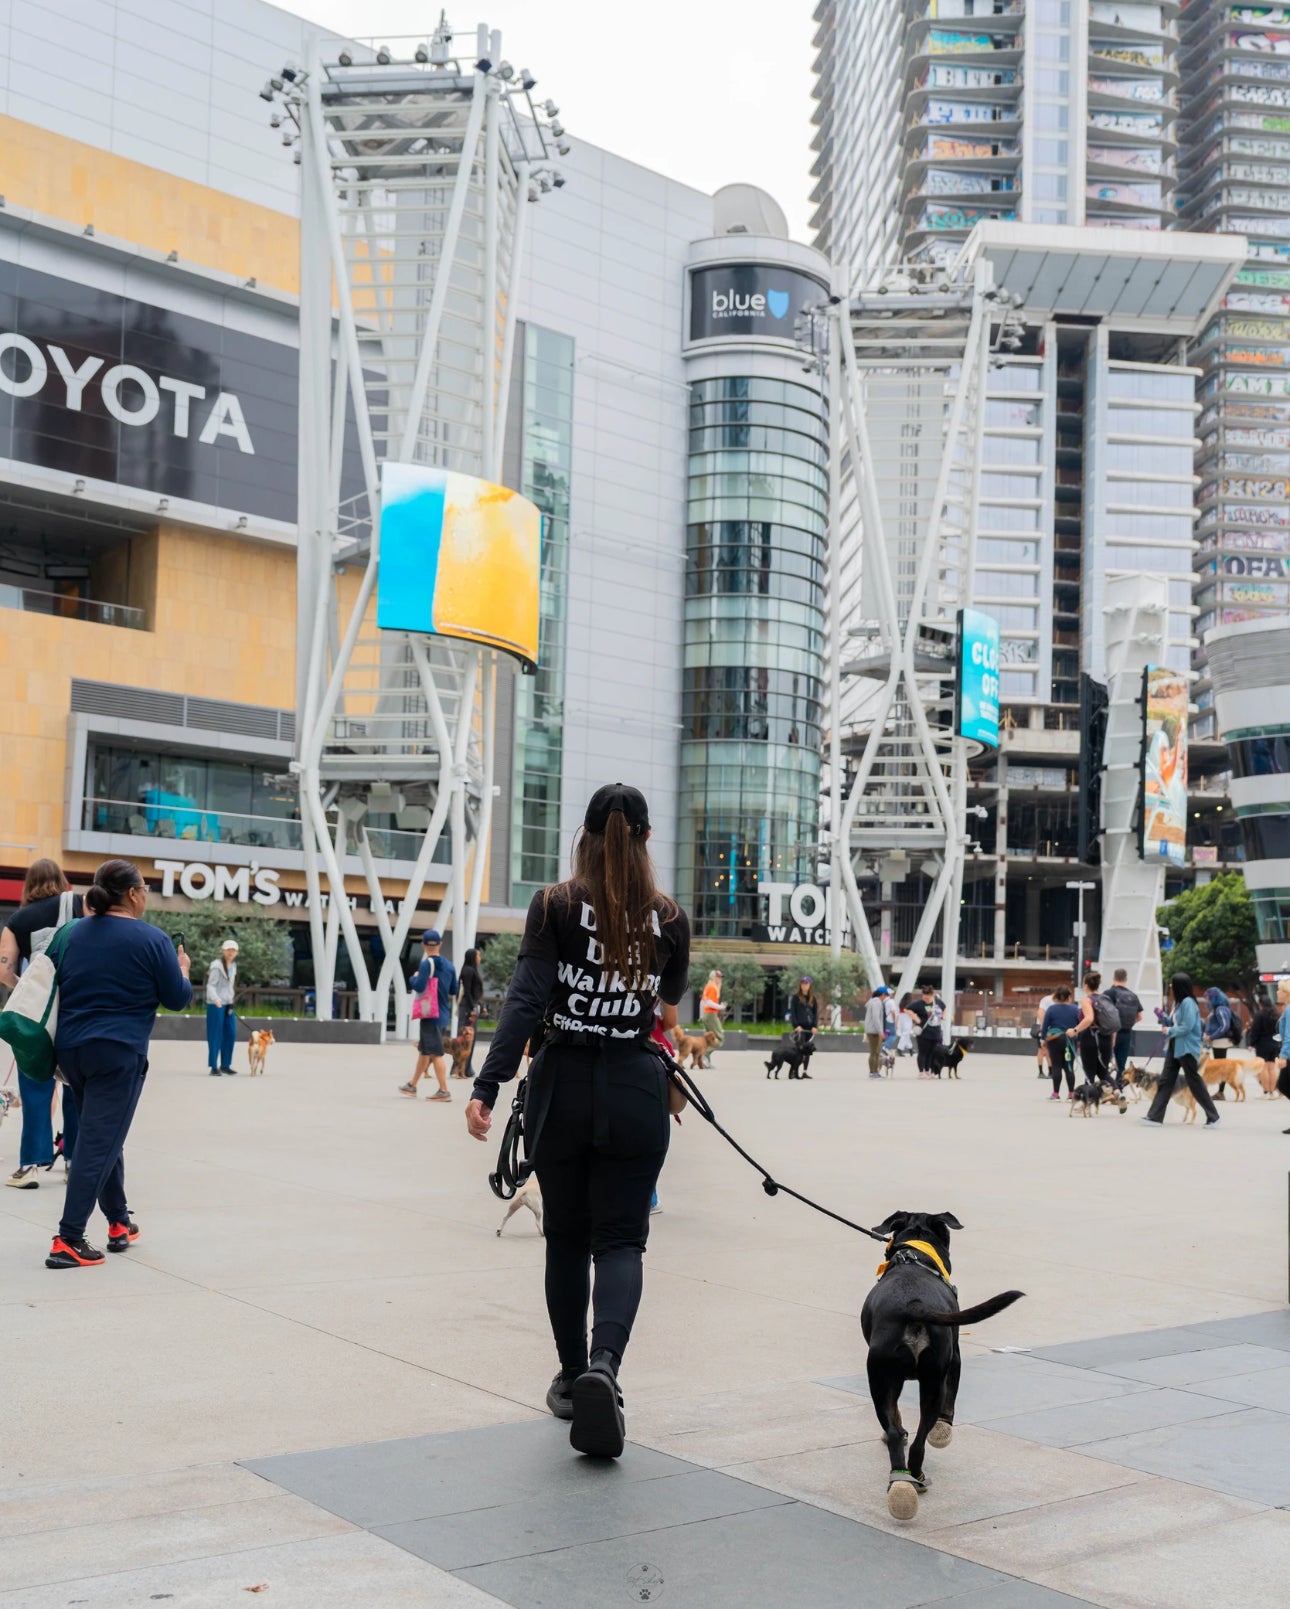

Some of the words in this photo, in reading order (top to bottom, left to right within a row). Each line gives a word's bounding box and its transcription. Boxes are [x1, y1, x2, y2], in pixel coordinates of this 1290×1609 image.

[712, 288, 766, 311] blue
[712, 309, 766, 319] CALIFORNIA
[154, 859, 281, 906] TOM'S
[557, 961, 661, 997] Walking
[567, 992, 641, 1017] Club
